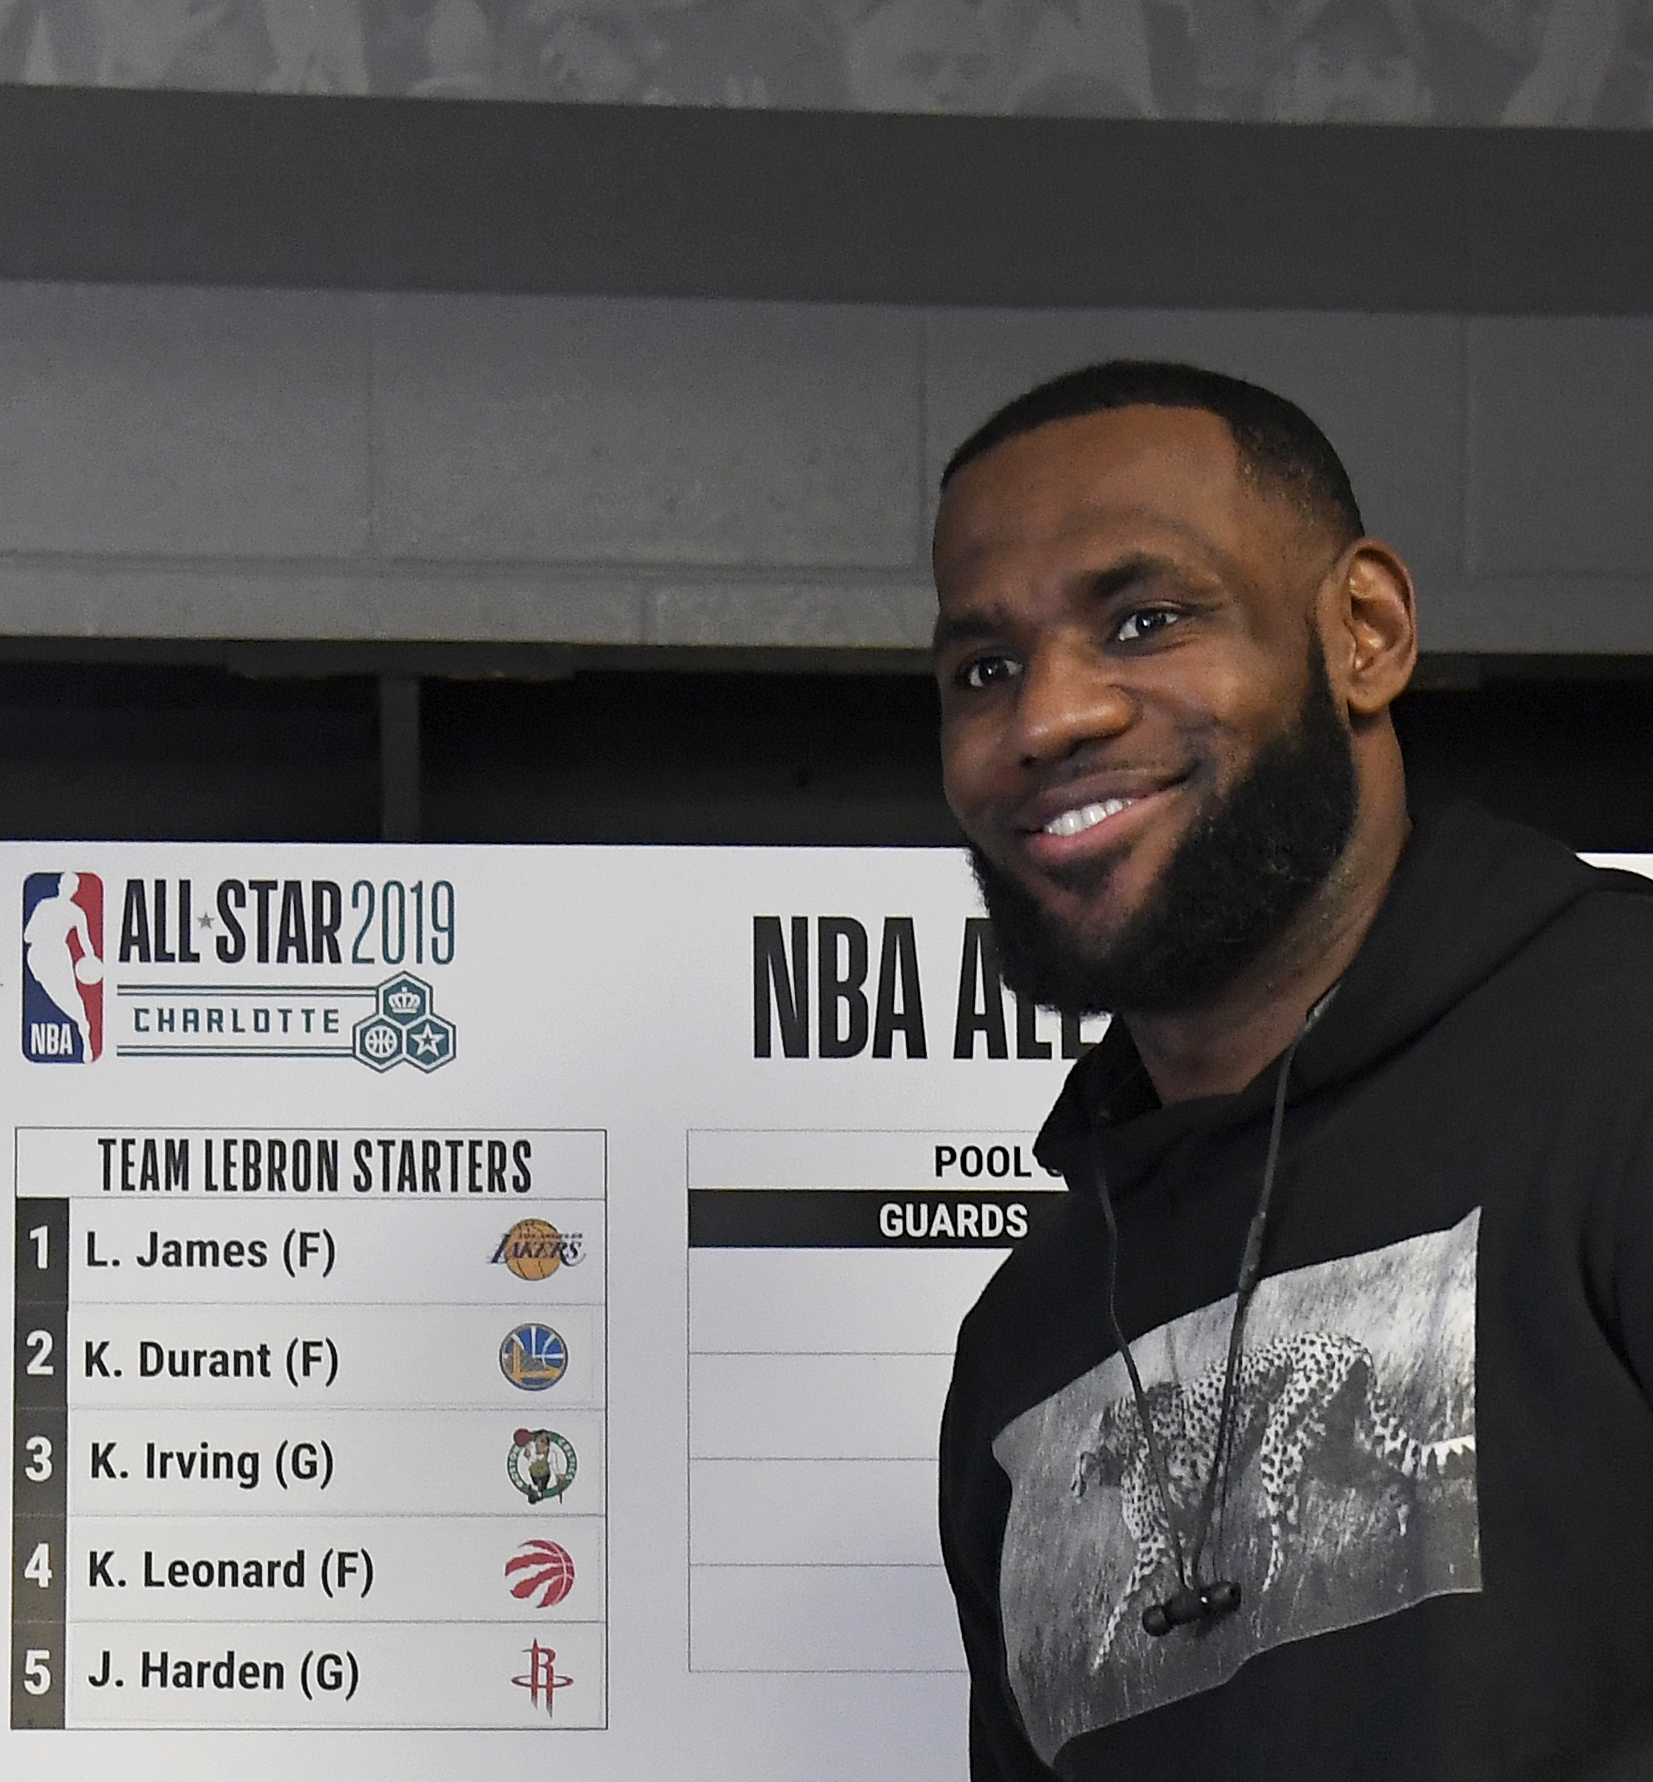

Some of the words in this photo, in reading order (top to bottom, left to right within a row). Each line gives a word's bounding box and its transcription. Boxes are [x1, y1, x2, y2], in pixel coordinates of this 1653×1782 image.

[351, 879, 455, 965] 2019
[752, 915, 928, 1060] NBA
[30, 1022, 73, 1055] NBA
[133, 1007, 339, 1034] CHARLOTTE
[97, 1138, 189, 1192] TEAM
[204, 1138, 339, 1193] LEBRON
[353, 1138, 532, 1194] STARTERS
[935, 1145, 1032, 1178] POOL
[879, 1203, 1028, 1238] GUARDS
[29, 1225, 48, 1269] 1
[87, 1231, 121, 1267] L.
[136, 1231, 268, 1268] James
[283, 1228, 335, 1278] (F)
[26, 1329, 54, 1376] 2
[85, 1340, 123, 1378] K.
[139, 1341, 271, 1378] Durant
[286, 1337, 339, 1388] (F)
[25, 1436, 53, 1482] 3
[91, 1442, 129, 1479] K.
[146, 1441, 259, 1490] Irving
[275, 1439, 334, 1490] (G)
[24, 1543, 53, 1588] 4
[89, 1550, 127, 1588] K.
[144, 1549, 305, 1588] Leonard
[321, 1547, 374, 1599] (F)
[23, 1649, 51, 1695] 5
[88, 1650, 124, 1688] J.
[141, 1650, 284, 1690] Harden
[300, 1650, 359, 1701] (G)
